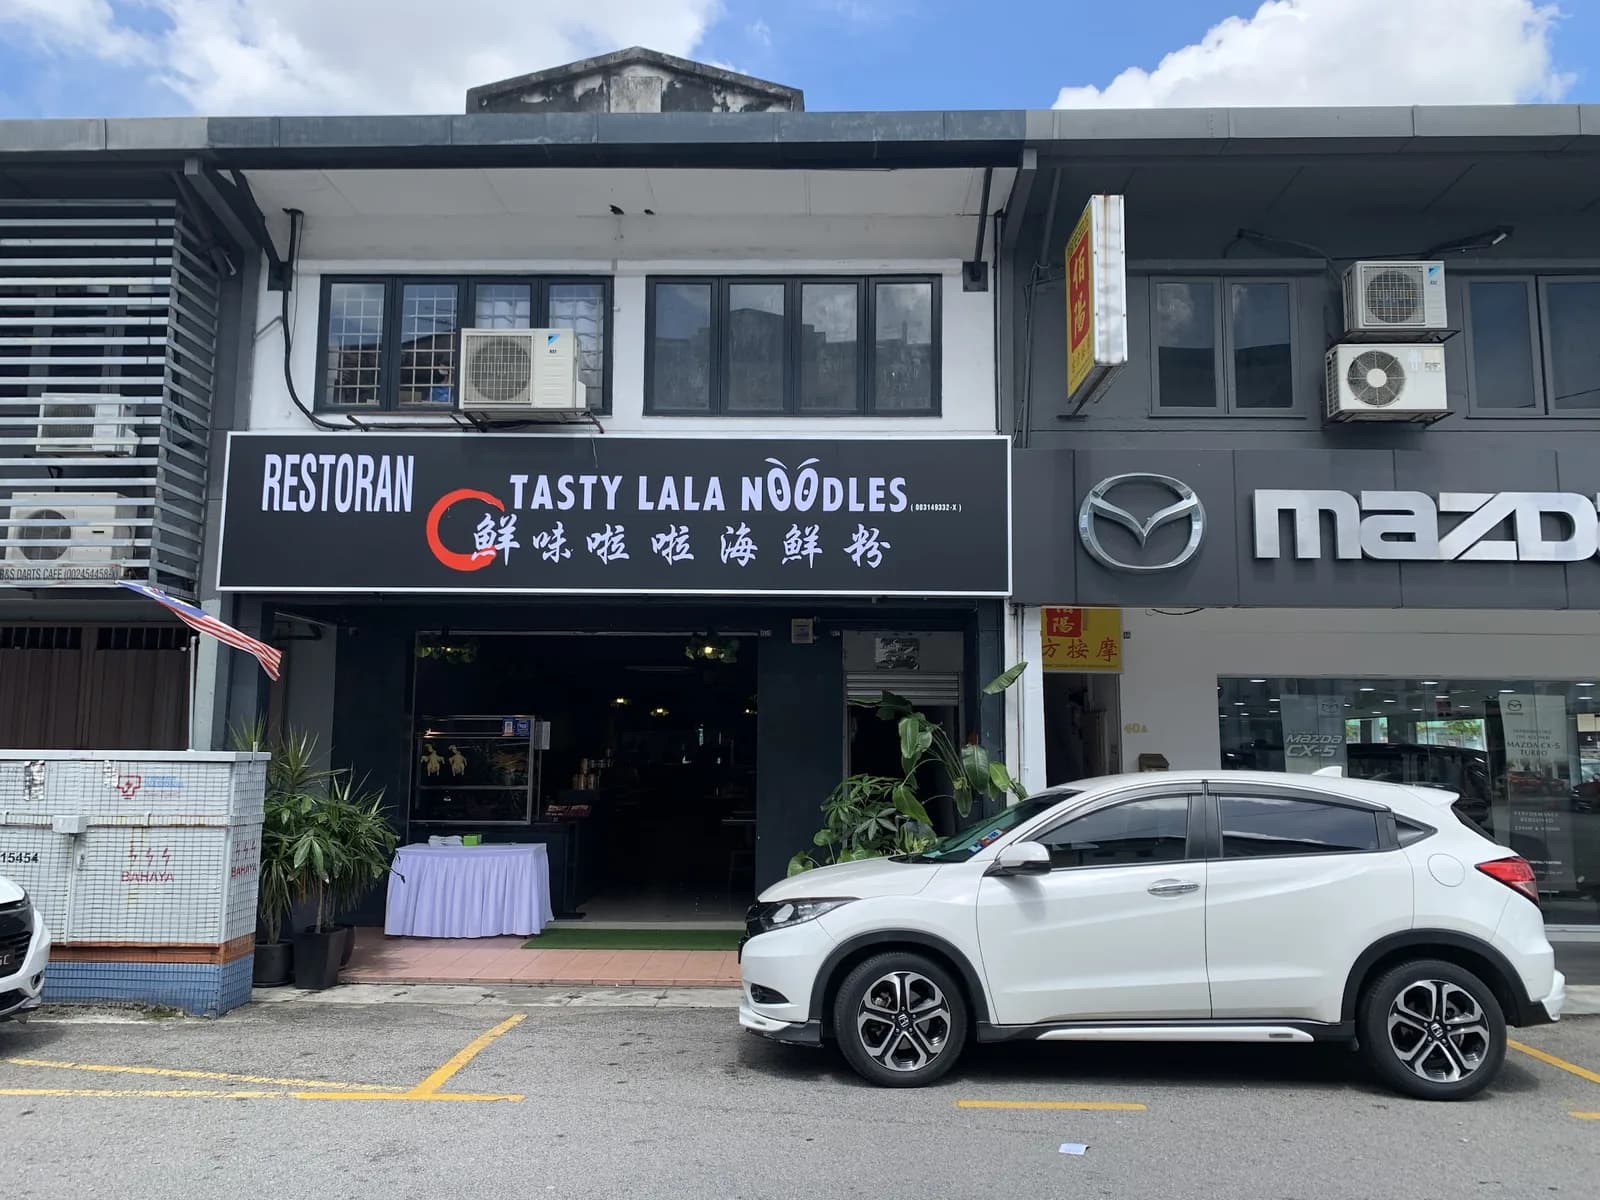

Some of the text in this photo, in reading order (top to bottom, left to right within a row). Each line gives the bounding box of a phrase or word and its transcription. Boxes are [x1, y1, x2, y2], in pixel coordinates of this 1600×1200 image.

[261, 453, 414, 513] RESTORAN
[509, 474, 623, 510] TASTY
[638, 475, 725, 511] LALA
[741, 467, 908, 513] NOODLES
[1254, 488, 1600, 562] mazD
[470, 512, 891, 569] 鮮味啦啦海鮮粉
[16, 567, 42, 580] DARTS
[43, 567, 62, 580] CAFE
[1042, 637, 1118, 662] 方按摩
[1286, 744, 1338, 757] CX-5
[1, 851, 39, 864] 15454
[120, 870, 175, 882] BAHAYA
[230, 863, 258, 878] BAHAYA
